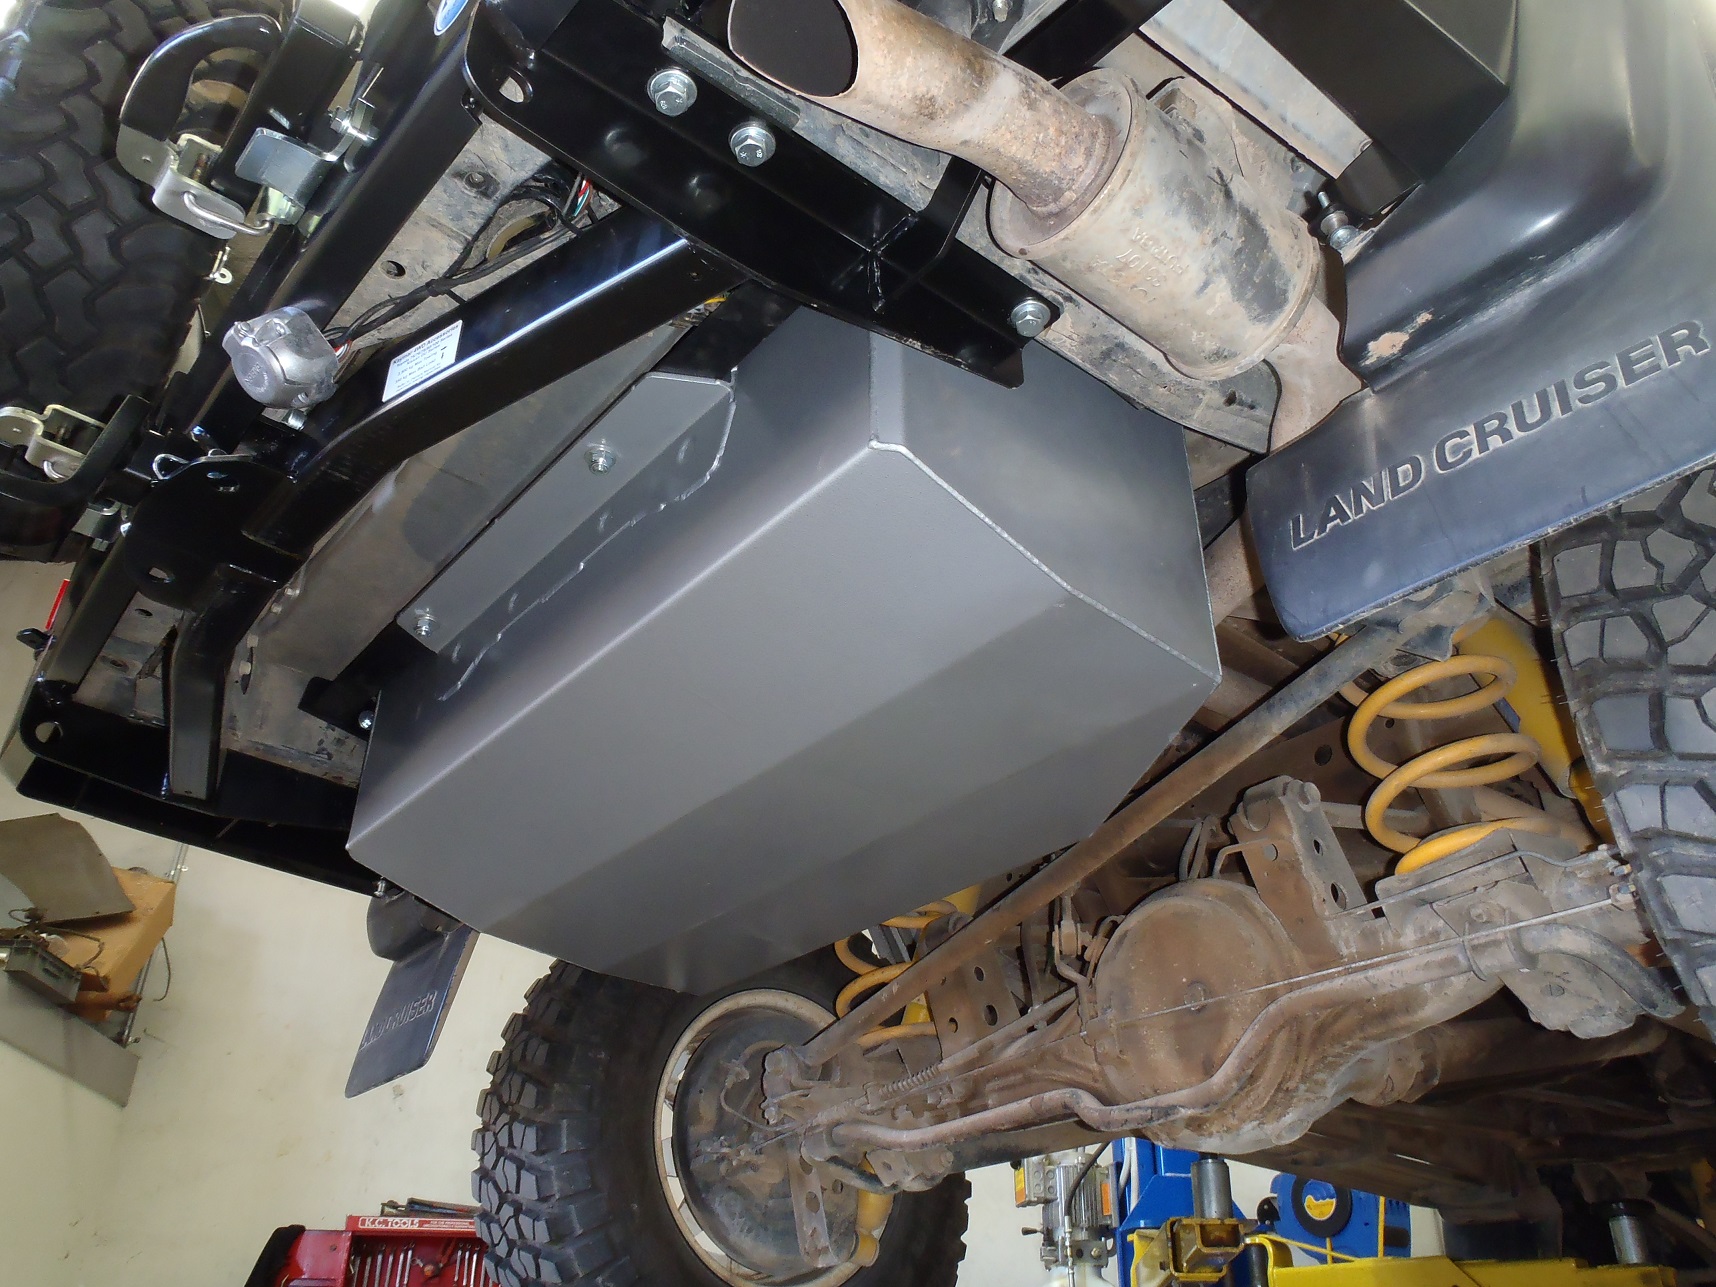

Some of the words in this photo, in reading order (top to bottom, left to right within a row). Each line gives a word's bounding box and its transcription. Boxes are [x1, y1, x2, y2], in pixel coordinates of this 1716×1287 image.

[1289, 454, 1425, 551] LAND
[1434, 319, 1712, 474] CRUISER
[387, 1219, 419, 1229] TOOLS
